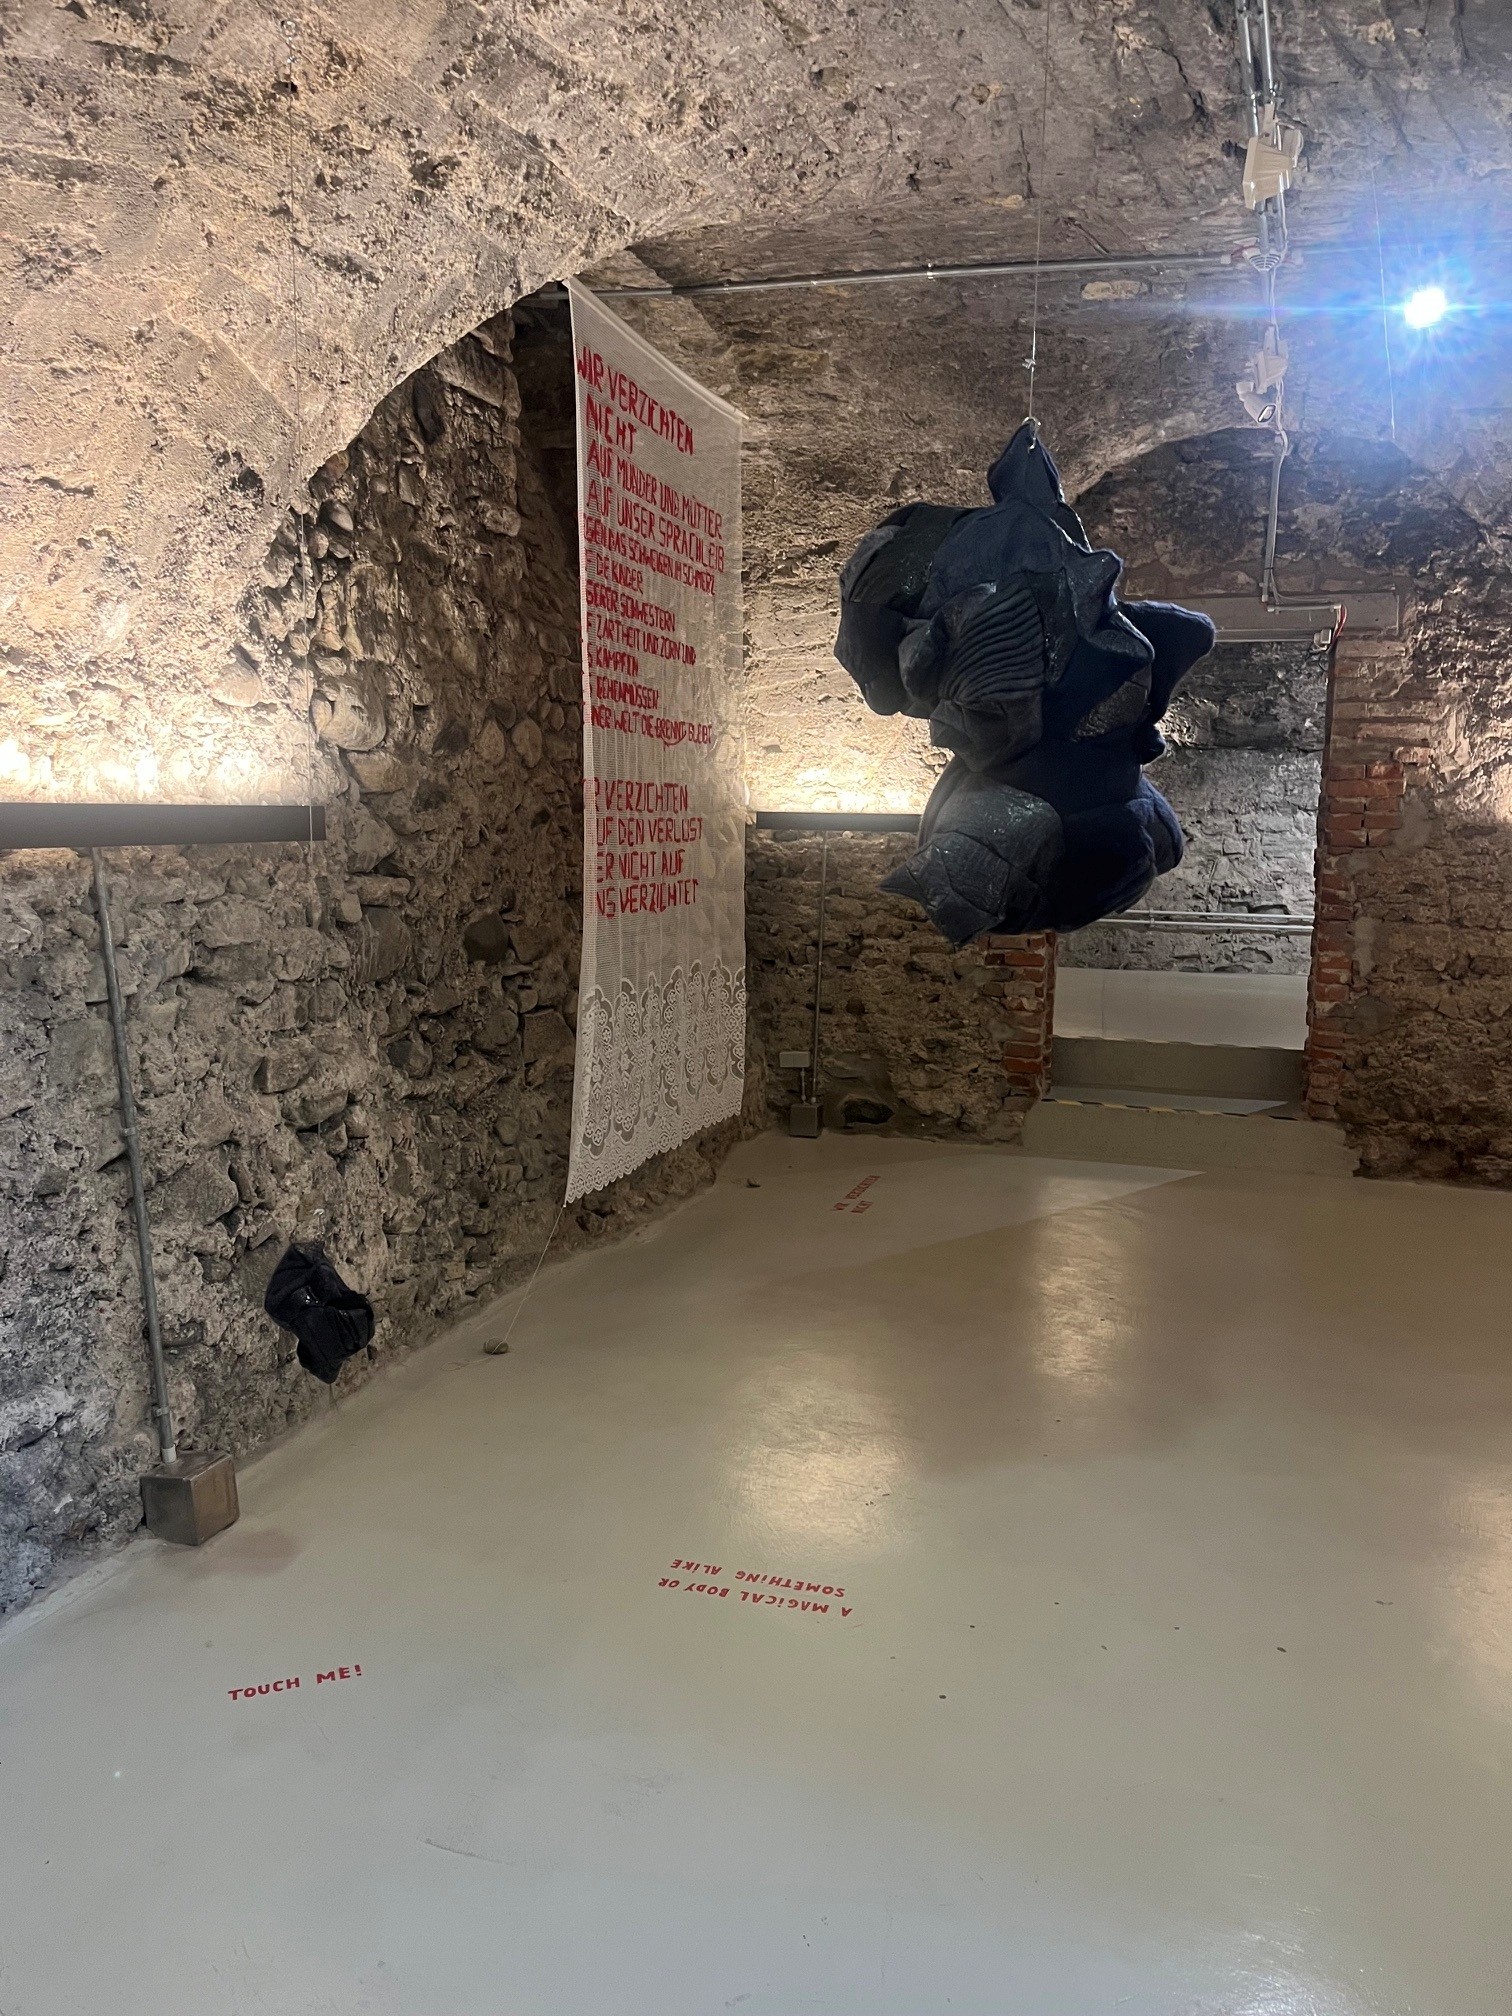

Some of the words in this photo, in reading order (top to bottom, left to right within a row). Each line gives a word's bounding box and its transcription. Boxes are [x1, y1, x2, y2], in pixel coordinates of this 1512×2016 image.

[577, 345, 604, 393] WIR
[607, 364, 694, 455] VERZICHTEN
[585, 392, 637, 455] NICHT
[586, 439, 613, 479] AUF
[659, 481, 679, 517] UND
[586, 479, 613, 518] AUF
[617, 493, 656, 542] UNSER
[604, 778, 689, 814] VERZICHTEN
[618, 817, 645, 847] DEN
[648, 816, 703, 843] VERLUST
[619, 850, 657, 881] NICHT
[661, 848, 685, 876] AUF
[619, 878, 699, 914] VERZICHTET
[658, 1577, 680, 1588] OR
[683, 1582, 730, 1598] BODY
[841, 1606, 853, 1617] A
[227, 1677, 300, 1701] TOUCH
[316, 1664, 362, 1685] ME!
